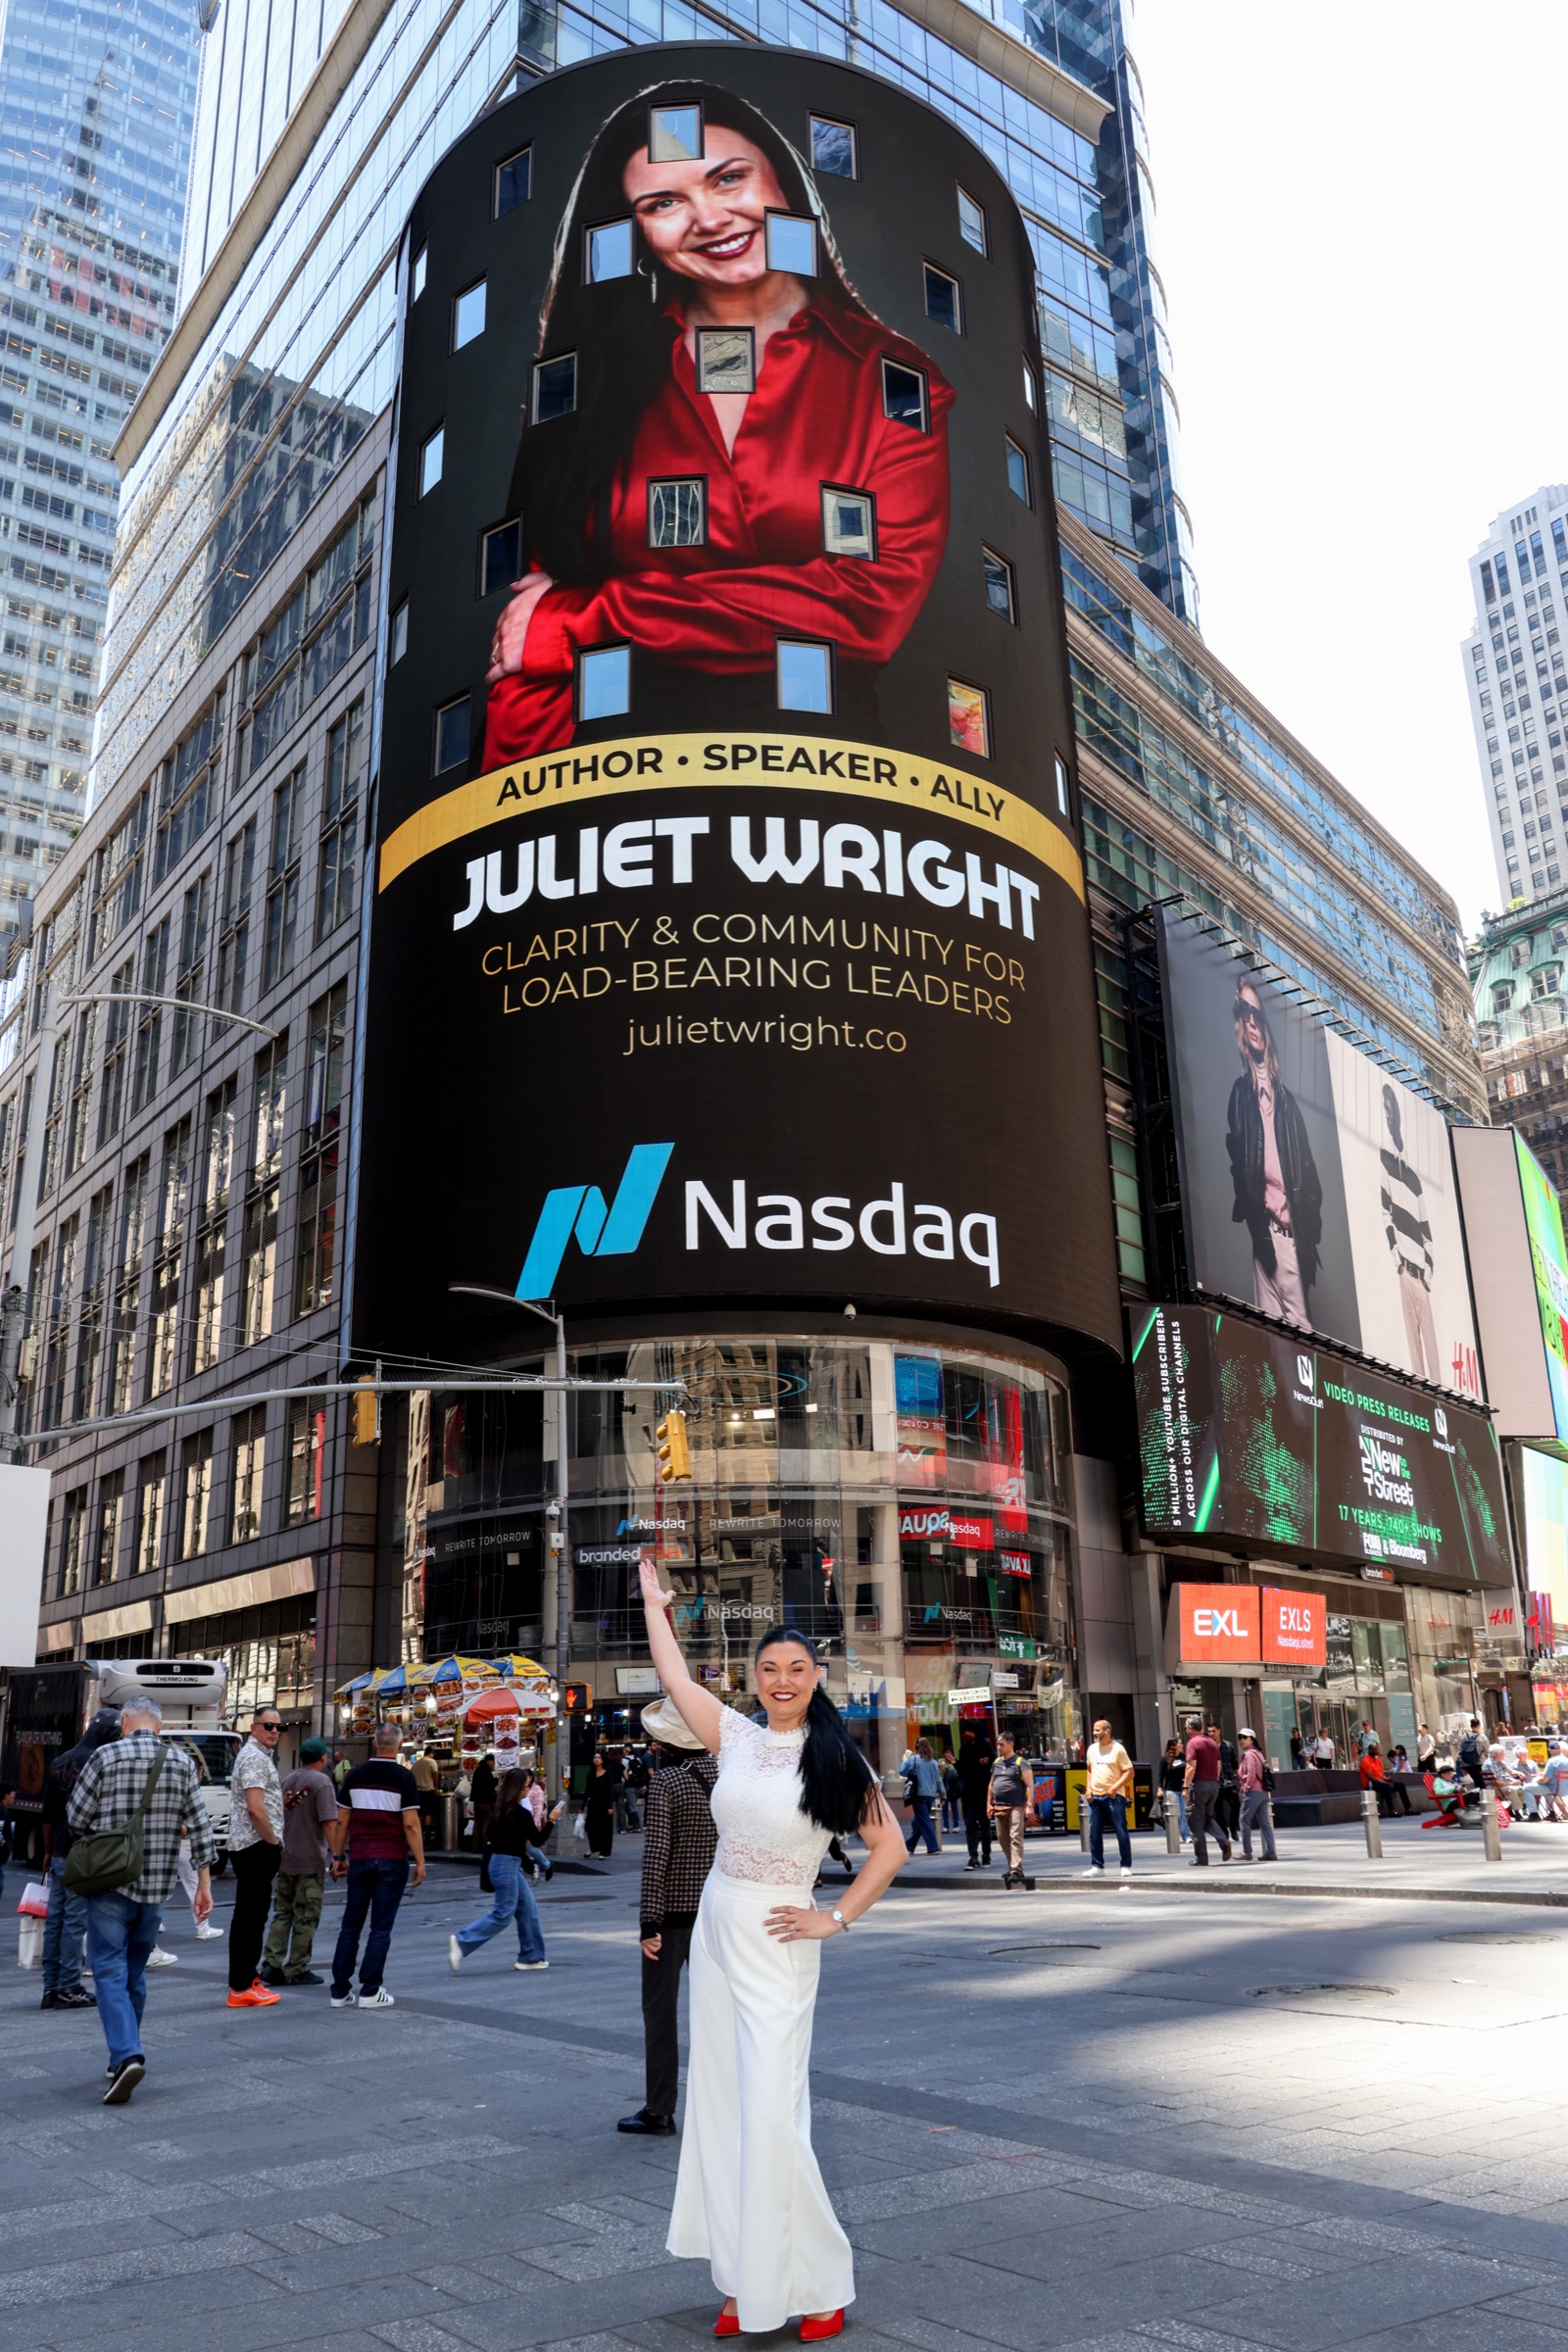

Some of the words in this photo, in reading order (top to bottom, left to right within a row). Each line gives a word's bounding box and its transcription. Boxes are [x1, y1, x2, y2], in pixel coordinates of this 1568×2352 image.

[495, 746, 663, 808] AUTHOR
[703, 743, 899, 788] SPEAKER
[930, 773, 1006, 822] ALLY
[453, 816, 710, 932] JULIET
[729, 814, 1041, 941] WRIGHT
[481, 917, 641, 976] CLARITY
[652, 915, 680, 946] &
[692, 912, 955, 967] COMMUNITY
[965, 944, 1026, 993] FOR
[503, 956, 831, 1014] LOAD-BEARING
[847, 961, 1012, 1026] LEADERS
[622, 1013, 907, 1055] julietwright.co
[685, 1178, 1001, 1288] Nasdaq
[1155, 1311, 1170, 1393] SUBSCRIBERS
[1171, 1320, 1186, 1384] CHANNELS
[1162, 1396, 1175, 1453] YOUTUBE
[1177, 1387, 1190, 1436] DIGITAL
[1323, 1381, 1354, 1406] VIDEO
[1357, 1394, 1386, 1417] PRESS
[1388, 1404, 1431, 1433] RELEASES
[1181, 1439, 1192, 1465] OUR
[1360, 1424, 1396, 1444] DISTRIBUTED
[1396, 1437, 1403, 1446] BY
[1370, 1439, 1401, 1477] New
[1168, 1456, 1181, 1516] MILLION+
[1185, 1468, 1197, 1518] ACROSS
[1374, 1471, 1414, 1507] Street
[445, 1538, 476, 1552] REWRITE
[478, 1530, 531, 1546] TOMORROW
[639, 1518, 686, 1532] Nasdaq
[709, 1519, 765, 1529] REWRITE
[771, 1518, 842, 1529] TOMORROW
[945, 1520, 981, 1537] Nasdaq
[995, 1528, 1026, 1543] REWRITE
[1338, 1504, 1348, 1522] 17
[1350, 1507, 1387, 1533] YEARS,
[1388, 1517, 1408, 1535] 740+
[1411, 1523, 1443, 1543] SHOWS
[1383, 1539, 1390, 1555] &
[1389, 1538, 1427, 1565] Bloomberg
[708, 1603, 774, 1623] Nasdaq
[942, 1607, 972, 1623] Nasdaq
[1193, 1609, 1249, 1638] EXL
[1279, 1605, 1311, 1633] EXLS
[1489, 1607, 1514, 1627] H&M
